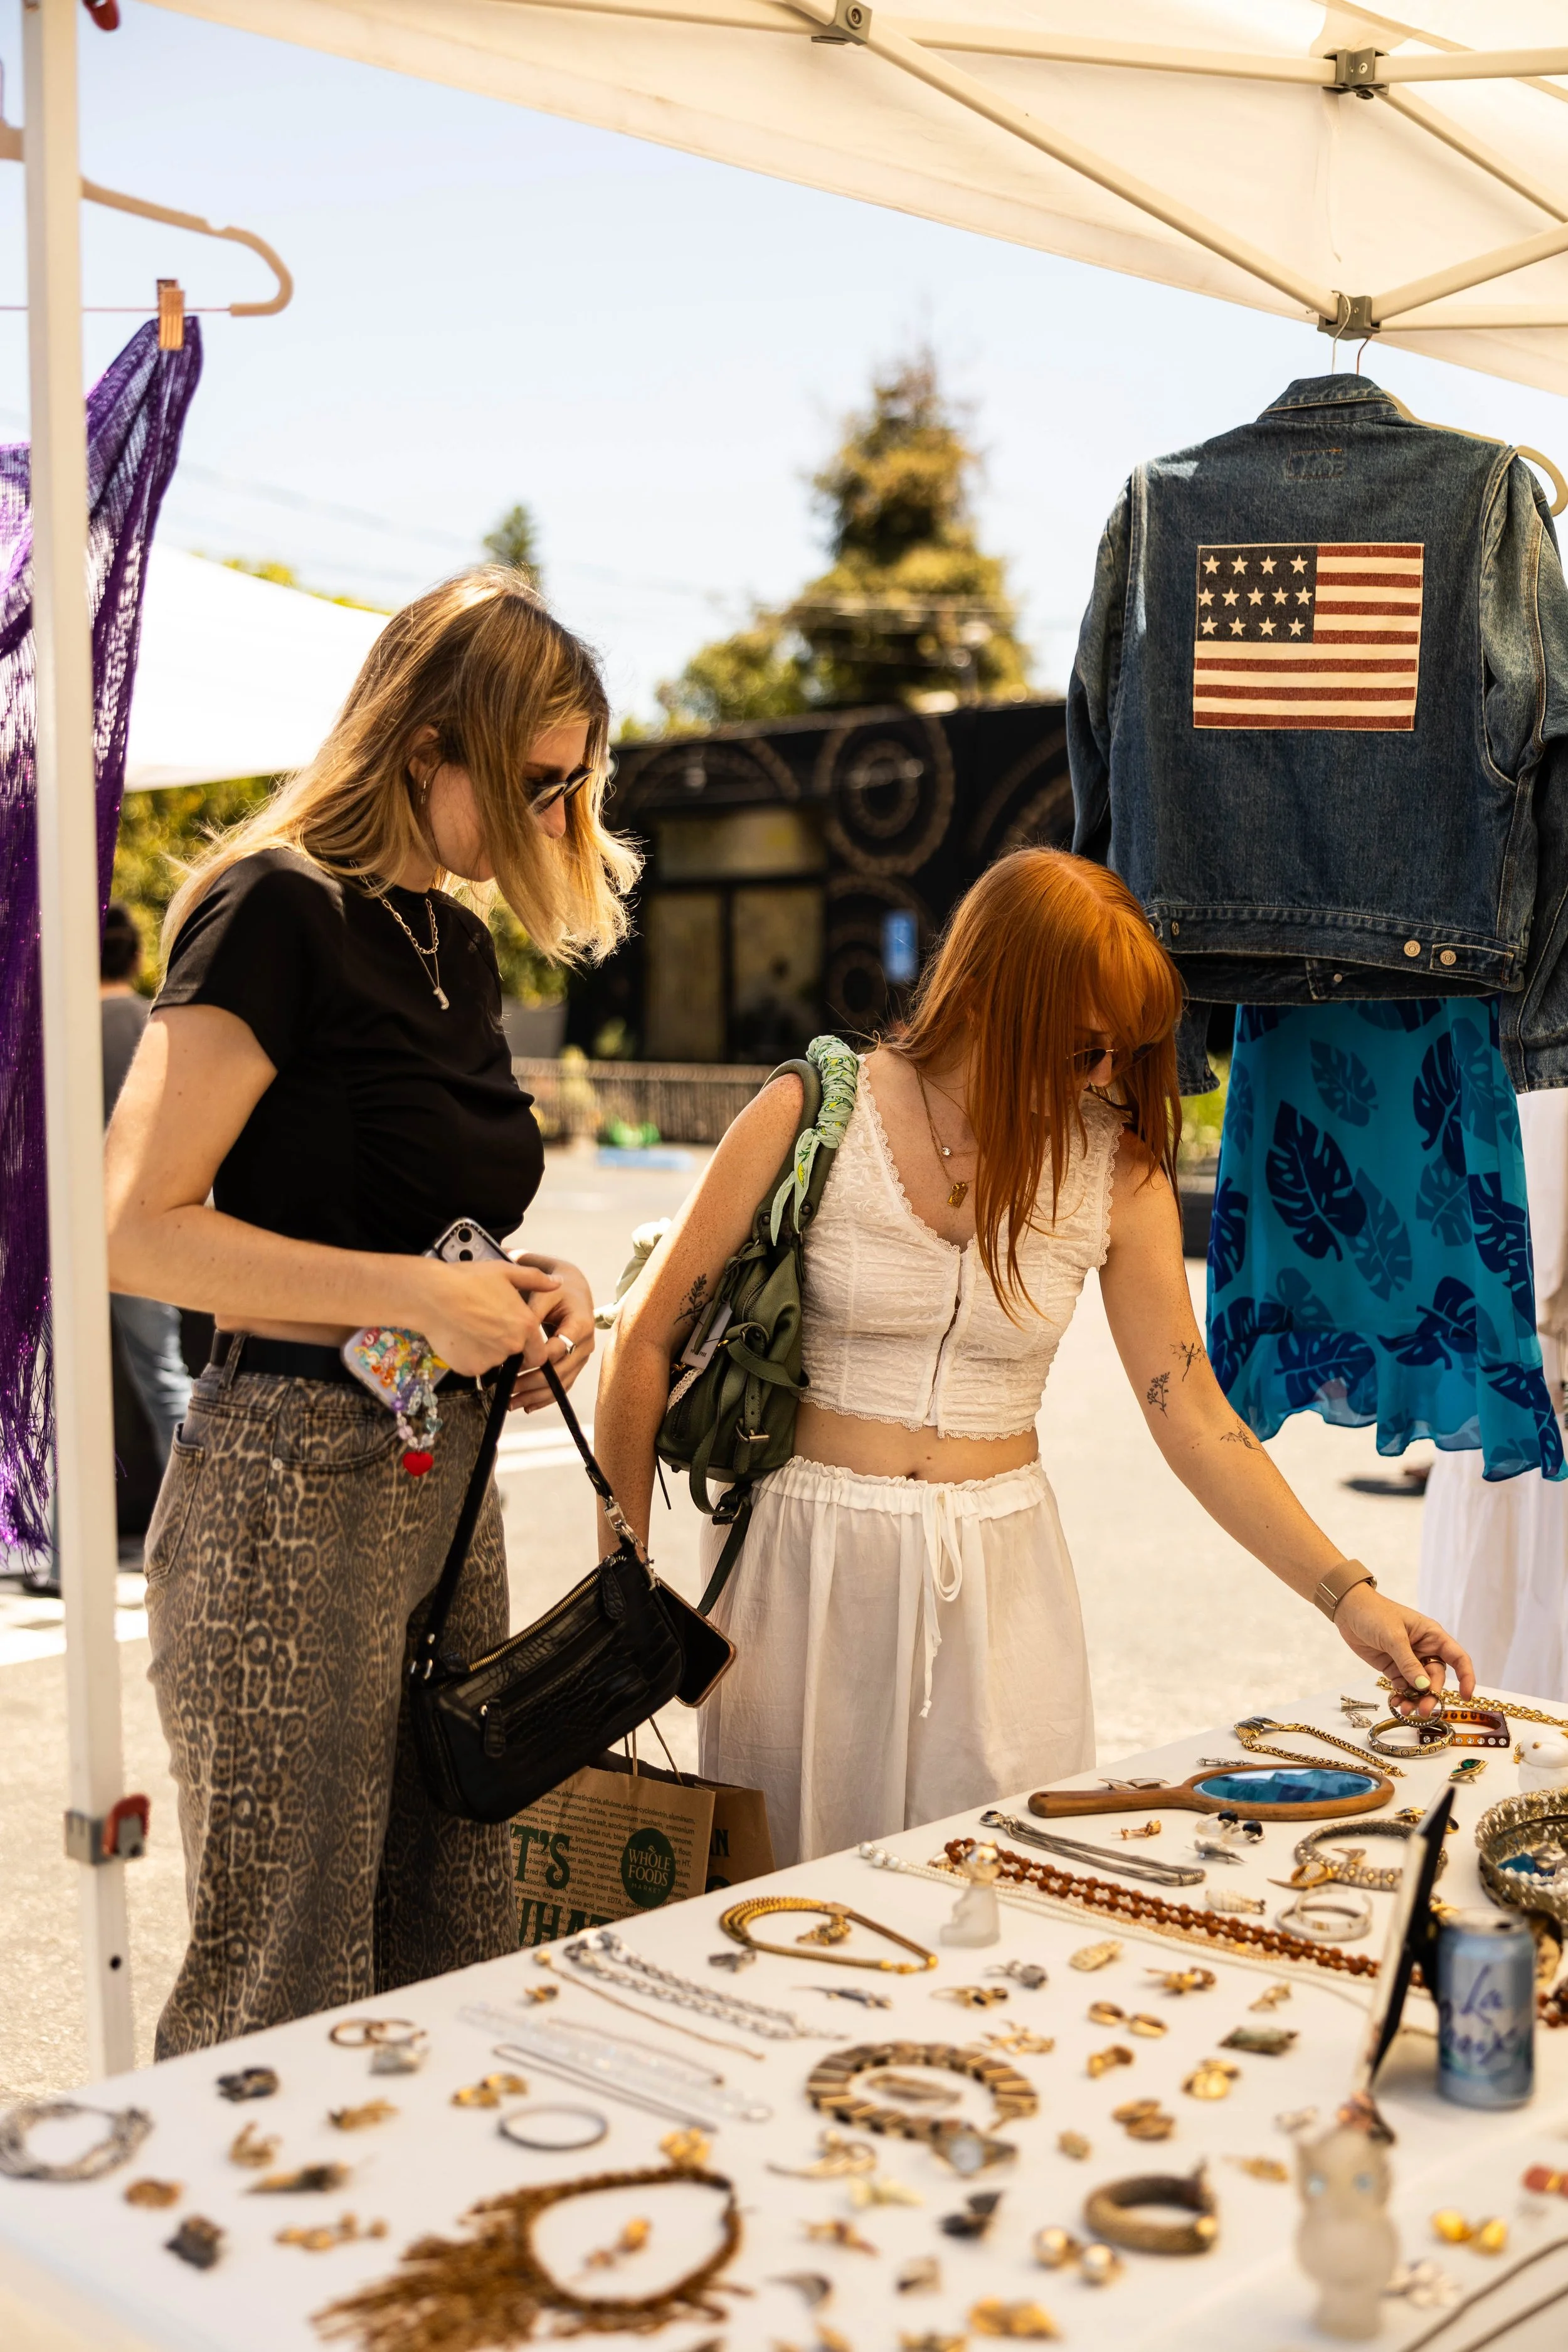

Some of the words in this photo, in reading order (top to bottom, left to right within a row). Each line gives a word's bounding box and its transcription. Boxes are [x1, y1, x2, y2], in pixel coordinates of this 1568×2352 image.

[542, 1798, 559, 1807] sulfate,
[588, 1807, 607, 1817] sulfate,
[610, 1812, 638, 1823] ammonium
[640, 1818, 664, 1829] saccharin,
[666, 1824, 695, 1835] ammonium
[603, 1799, 623, 1809] allulose,
[623, 1803, 669, 1820] alpha-cyclodextrin,
[541, 1817, 585, 1834] beta-cyclodextrin,
[601, 1831, 612, 1840] nut,
[613, 1833, 627, 1842] black
[596, 1820, 608, 1828] salt,
[575, 1835, 605, 1847] brominated
[579, 1846, 619, 1863] hydroxytoluene,
[628, 1848, 671, 1872] WHOLE
[578, 1858, 595, 1867] sulfite,
[596, 1862, 616, 1872] calcium
[579, 1868, 596, 1878] sulfite,
[628, 1864, 668, 1887] FOODS
[576, 1878, 591, 1888] silver,
[592, 1882, 608, 1892] cricket
[609, 1885, 622, 1895] flour,
[631, 1883, 662, 1895] MARKET
[543, 1891, 553, 1899] foie
[554, 1895, 566, 1904] gras,
[568, 1897, 582, 1907] fulvic
[583, 1902, 595, 1910] acid,
[570, 1887, 595, 1899] disodium
[596, 1893, 606, 1902] iron
[607, 1896, 623, 1907] EDTA,
